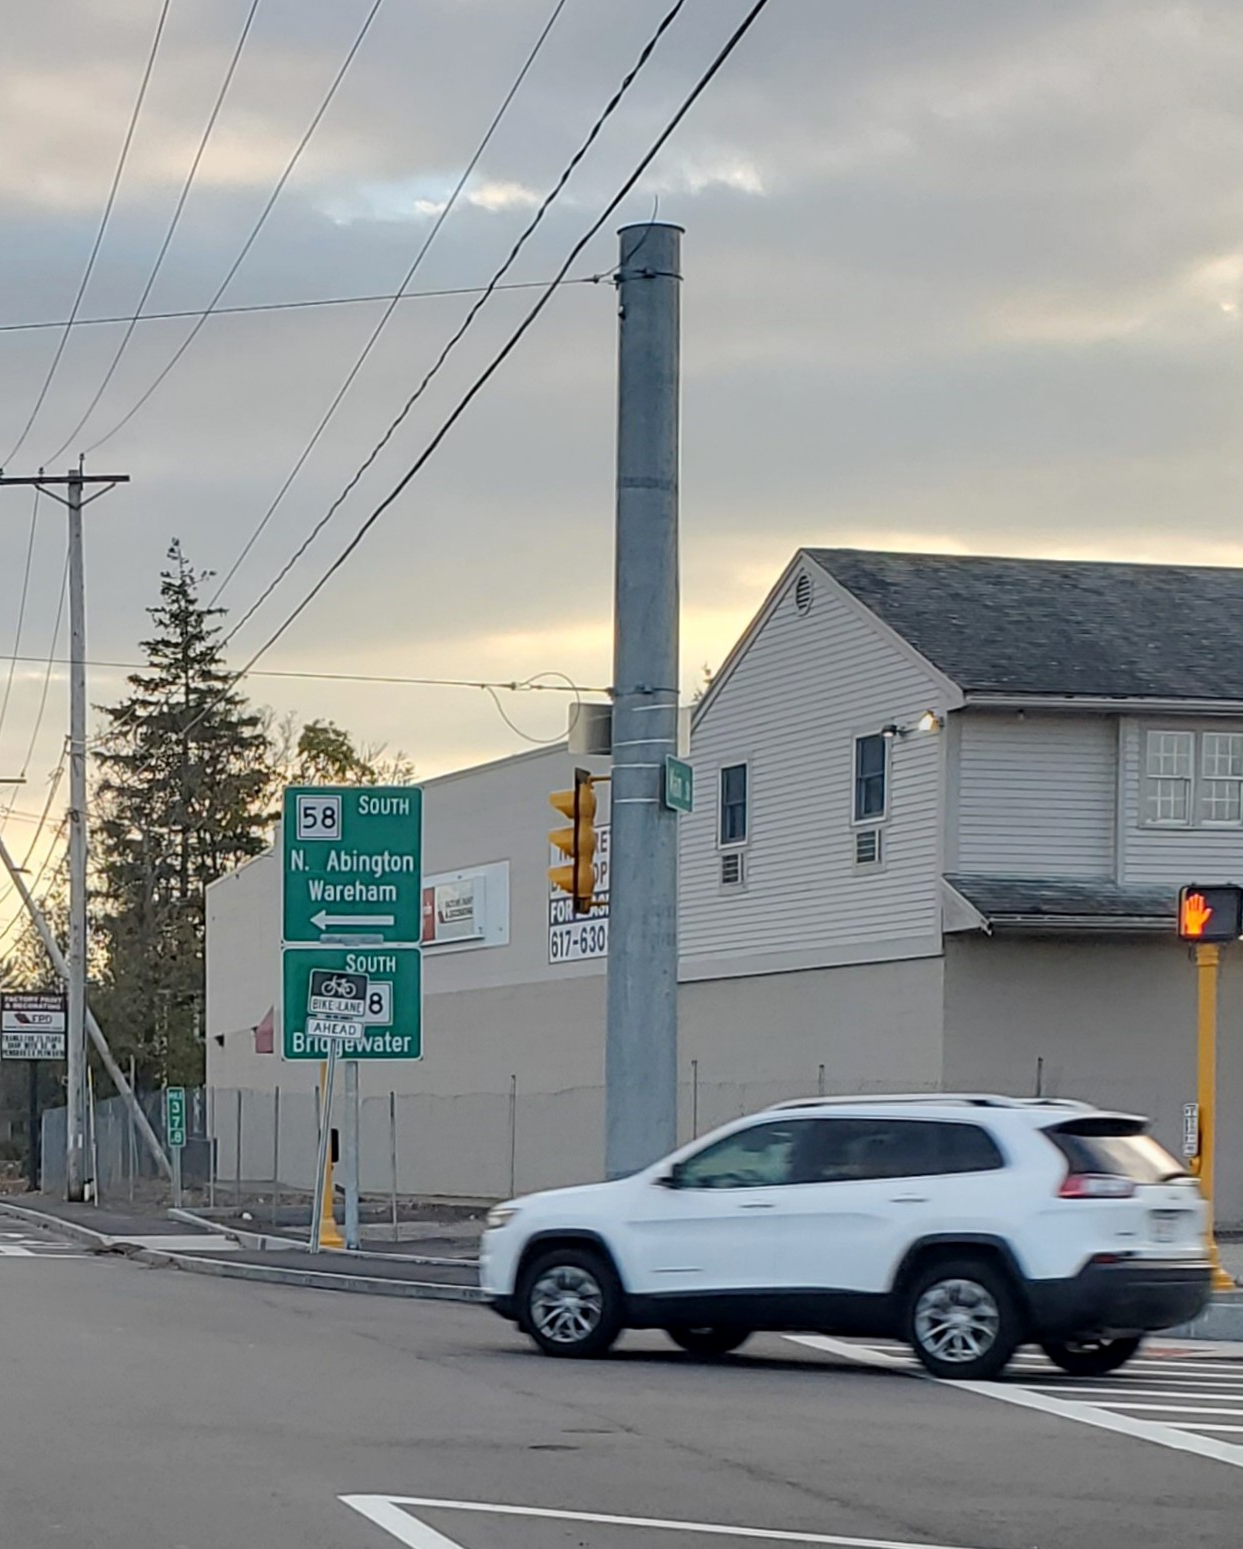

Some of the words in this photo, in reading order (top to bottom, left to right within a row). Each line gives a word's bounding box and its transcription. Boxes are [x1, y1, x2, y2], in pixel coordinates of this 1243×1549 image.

[303, 806, 336, 829] 58
[291, 849, 310, 872] N.
[326, 850, 414, 878] Abington
[308, 879, 397, 902] Wareham
[550, 900, 573, 924] FOR
[312, 998, 334, 1009] BIKE
[337, 1000, 362, 1014] LANE
[368, 992, 383, 1015] 8
[313, 1021, 357, 1036] AHEAD
